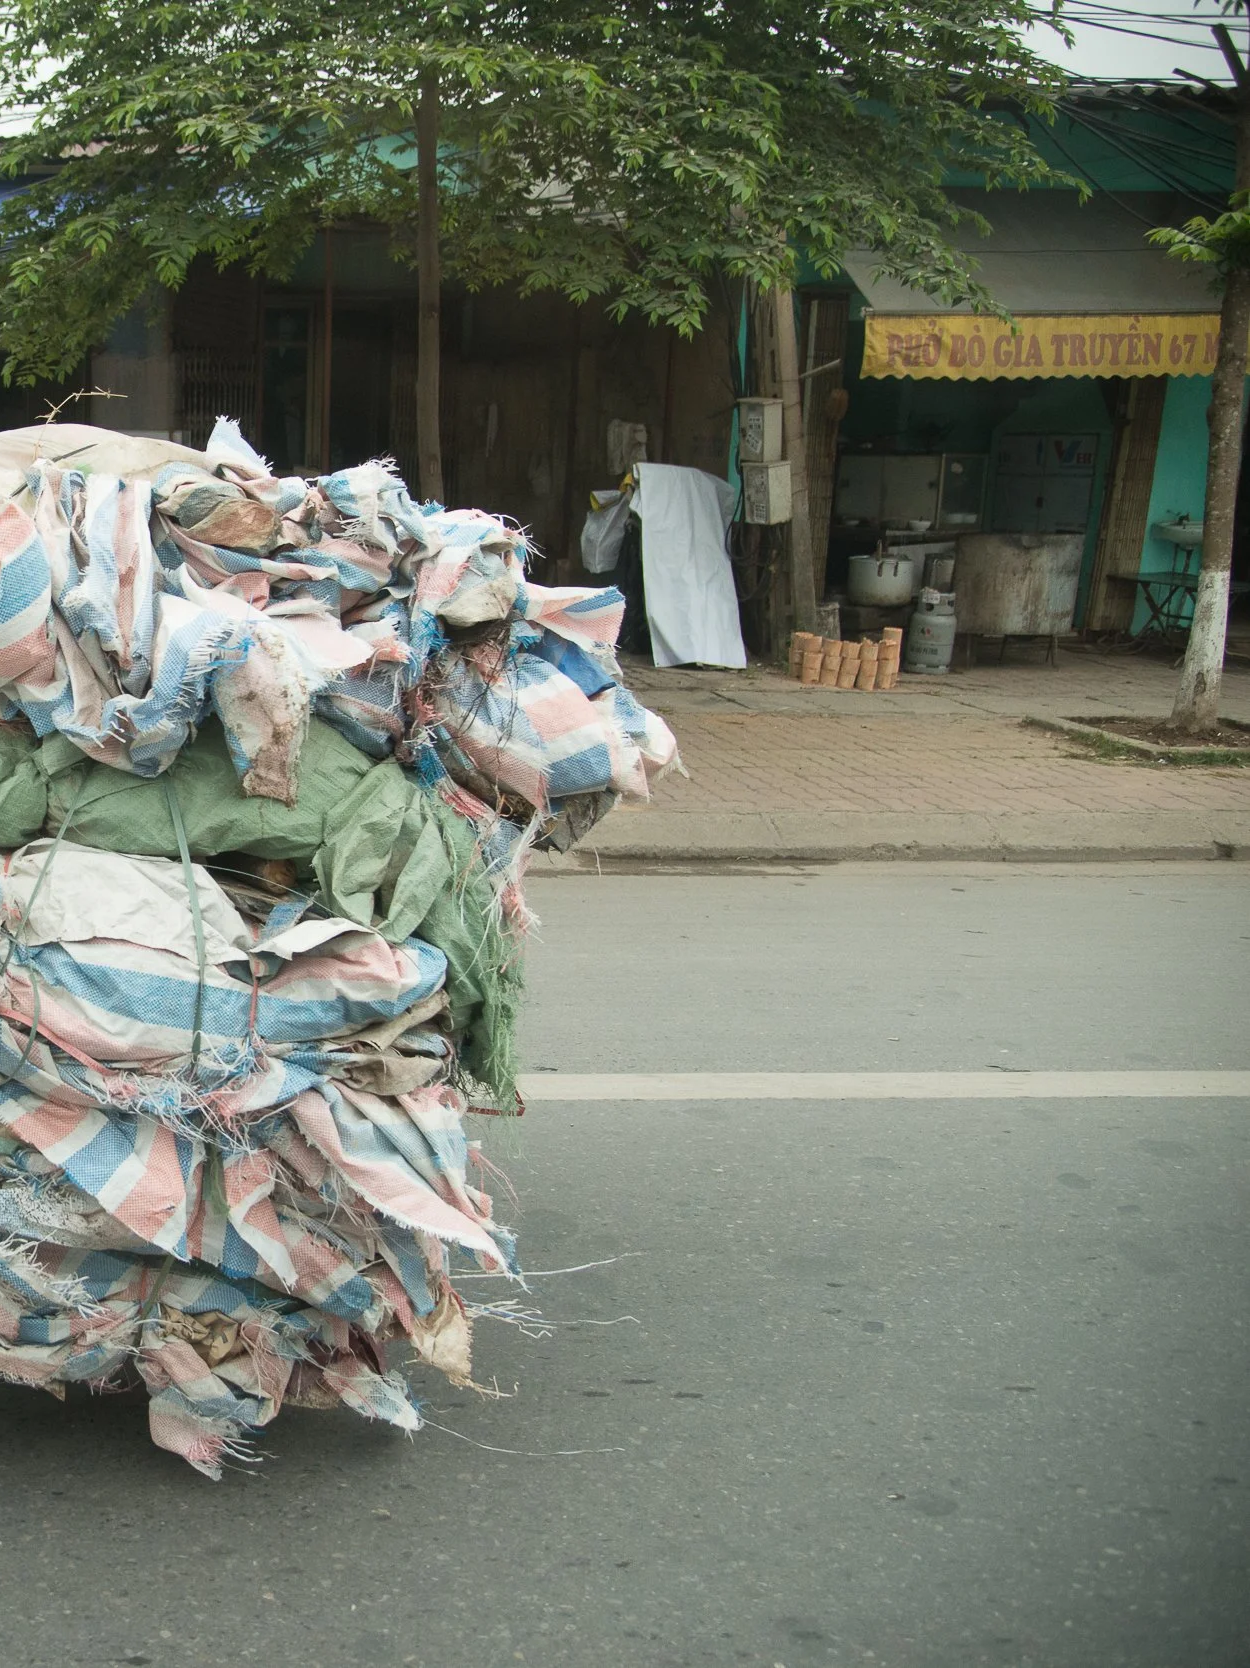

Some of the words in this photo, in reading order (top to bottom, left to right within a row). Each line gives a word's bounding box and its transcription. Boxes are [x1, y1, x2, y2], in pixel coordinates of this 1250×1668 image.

[887, 320, 944, 367] PHỞ
[949, 324, 985, 368] BÒ
[993, 334, 1044, 368] GIA
[1051, 315, 1163, 367] TRUYỀN
[1168, 334, 1197, 366] 67
